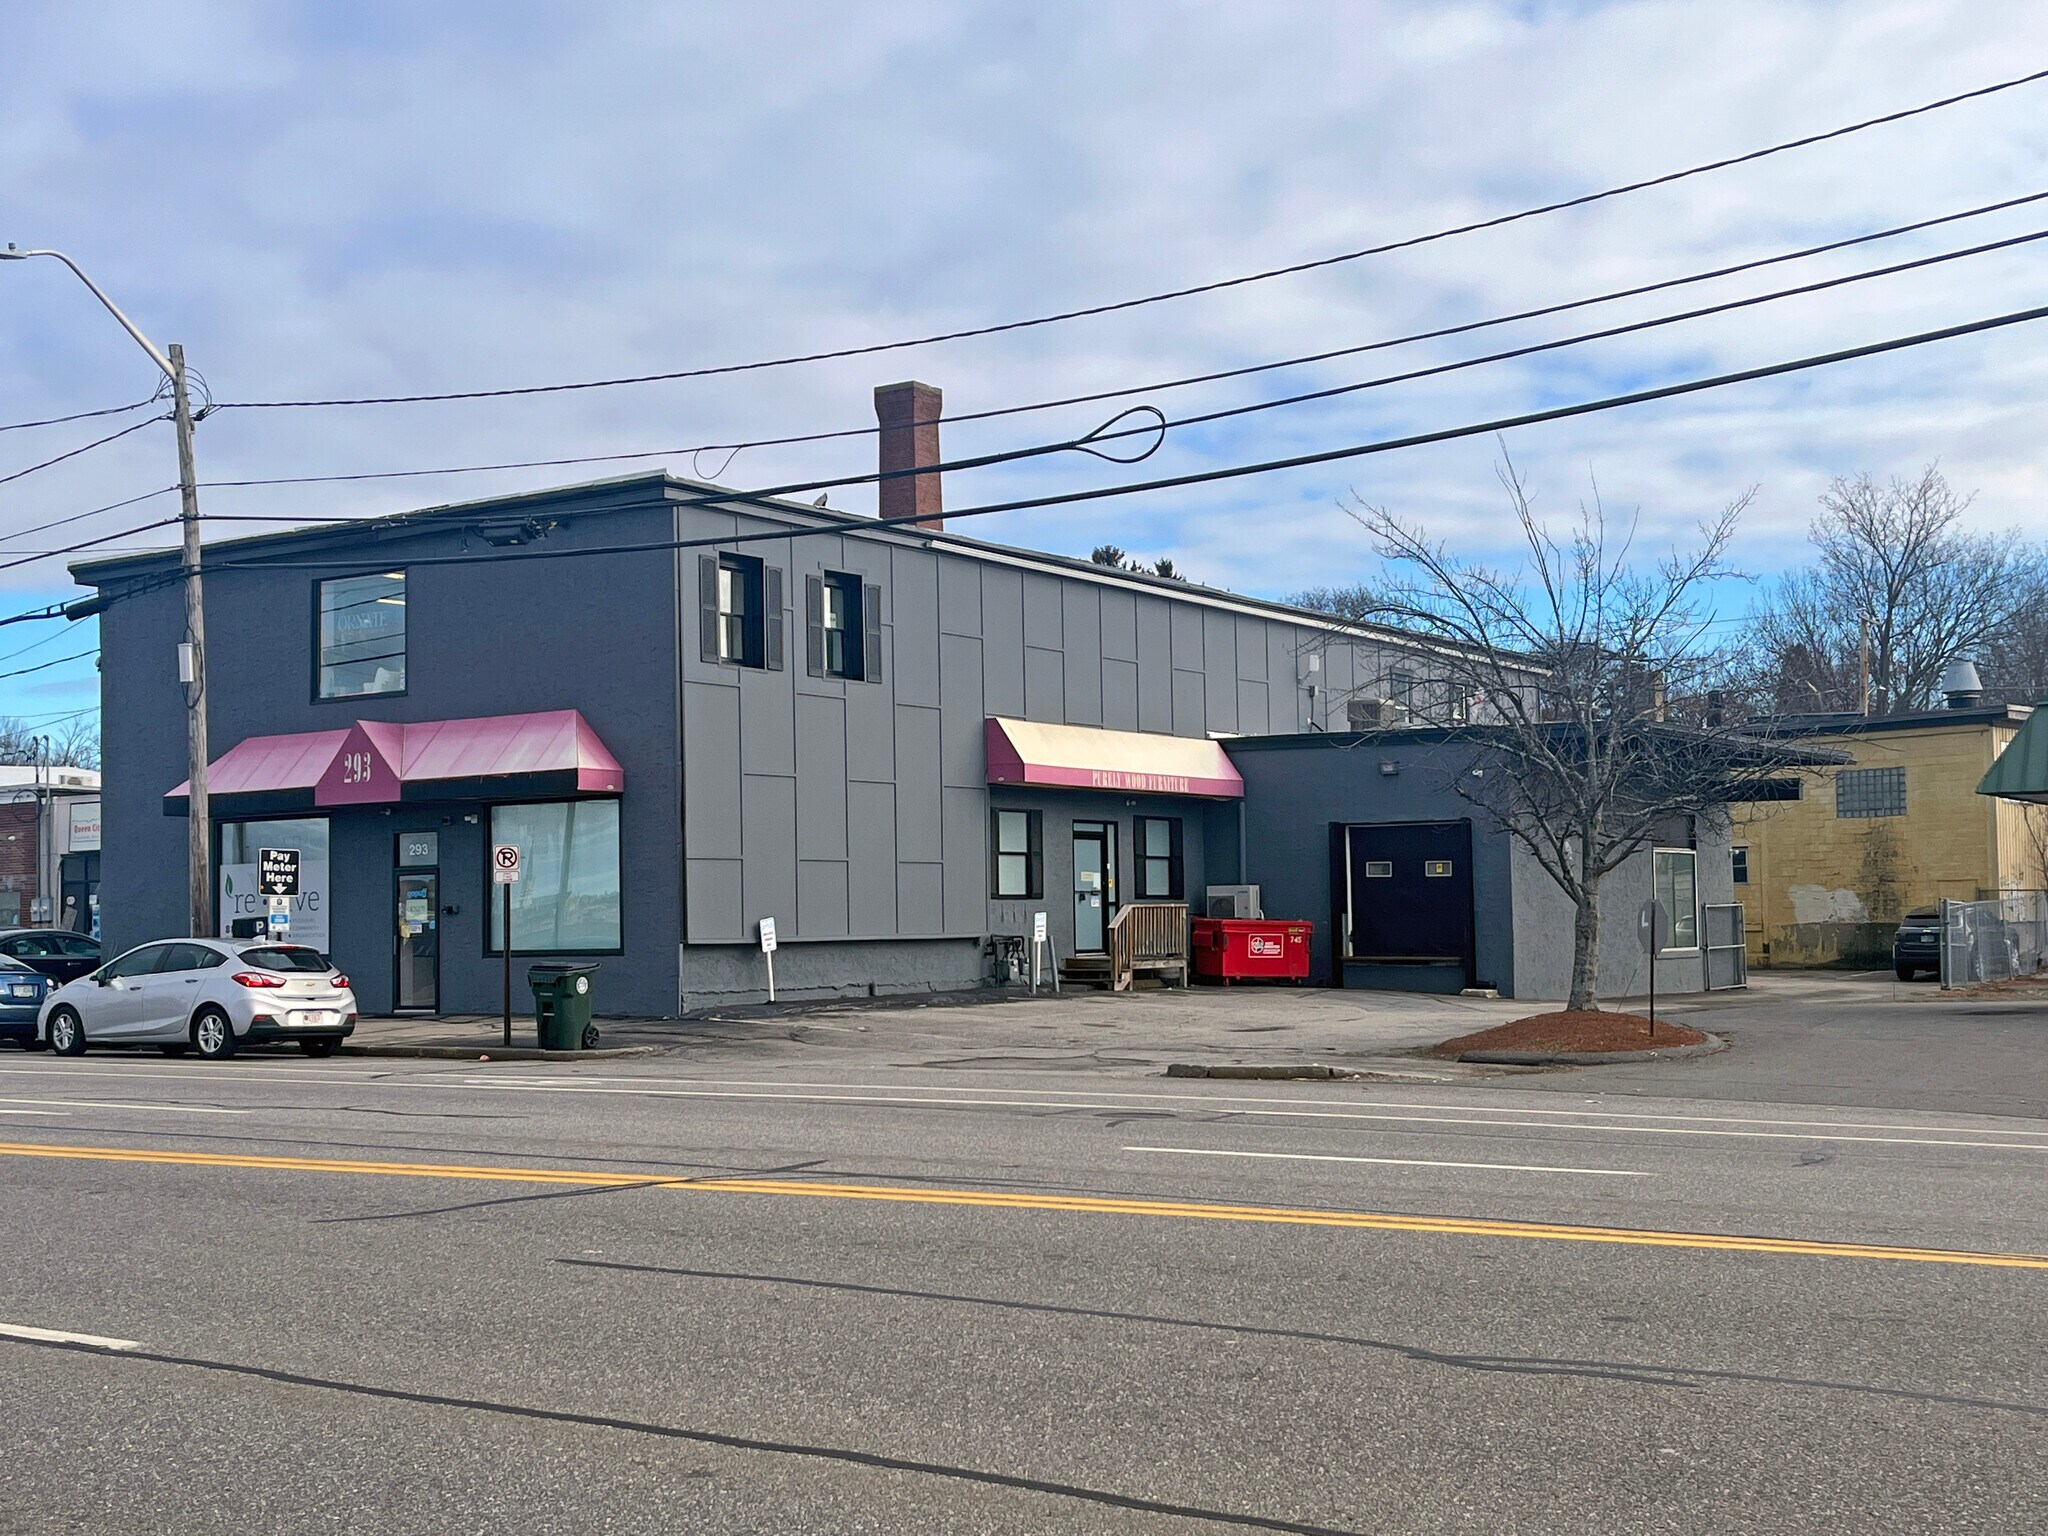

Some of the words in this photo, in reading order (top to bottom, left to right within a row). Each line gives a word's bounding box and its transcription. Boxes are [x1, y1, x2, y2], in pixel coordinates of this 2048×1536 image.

[344, 752, 371, 783] 293
[1092, 770, 1121, 788] PURELY
[1125, 773, 1147, 790] WOOD
[1149, 776, 1189, 793] FURNITURE
[409, 844, 429, 856] 293
[269, 850, 291, 863] Pay
[263, 861, 297, 872] Meter
[266, 872, 294, 883] Here
[256, 921, 264, 933] P
